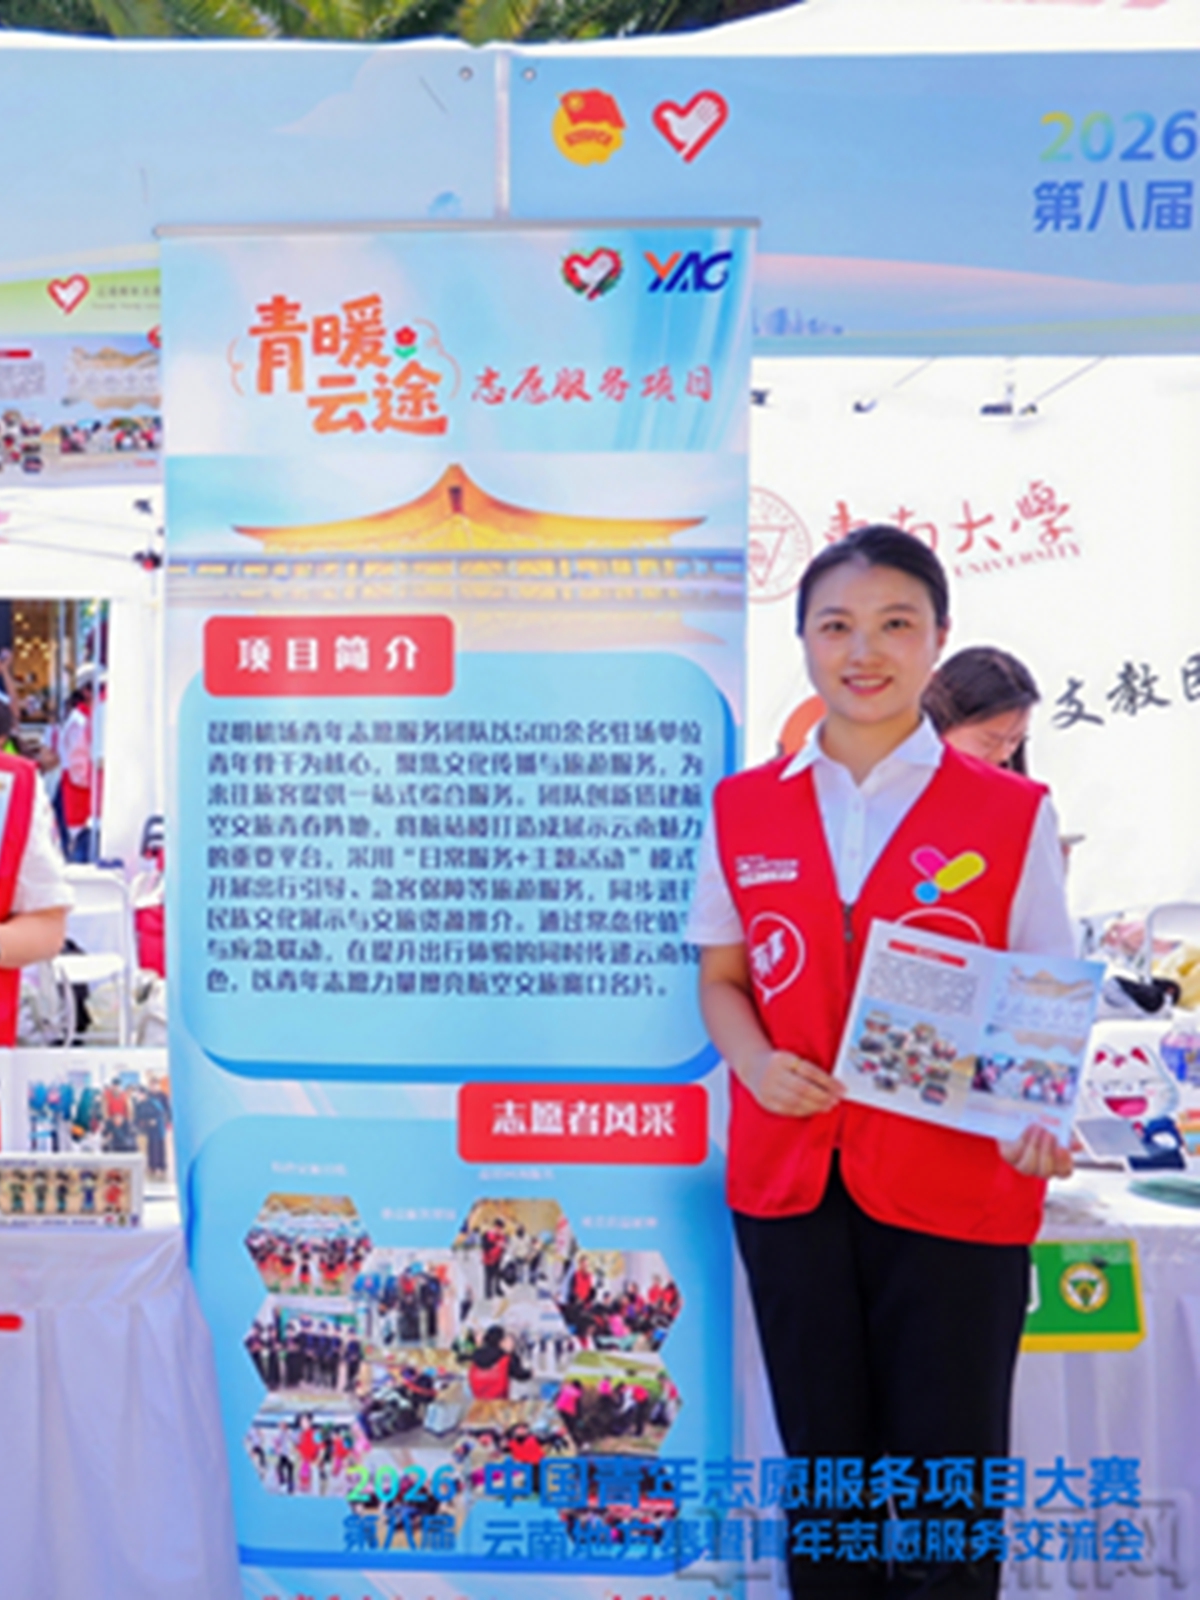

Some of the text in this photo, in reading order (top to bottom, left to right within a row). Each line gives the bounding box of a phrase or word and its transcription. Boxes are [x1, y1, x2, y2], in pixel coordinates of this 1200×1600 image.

[1039, 109, 1199, 164] 2026
[1032, 180, 1194, 233] 第八届
[643, 250, 733, 294] YAG
[248, 293, 393, 395] 青暖
[306, 360, 449, 437] 云途
[470, 365, 714, 406] 志愿服务项目
[237, 635, 419, 673] 项目简介
[207, 908, 688, 933] 民族文化展示与文旅资源推介。通过常态化值
[491, 1099, 677, 1139] 志愿者风采
